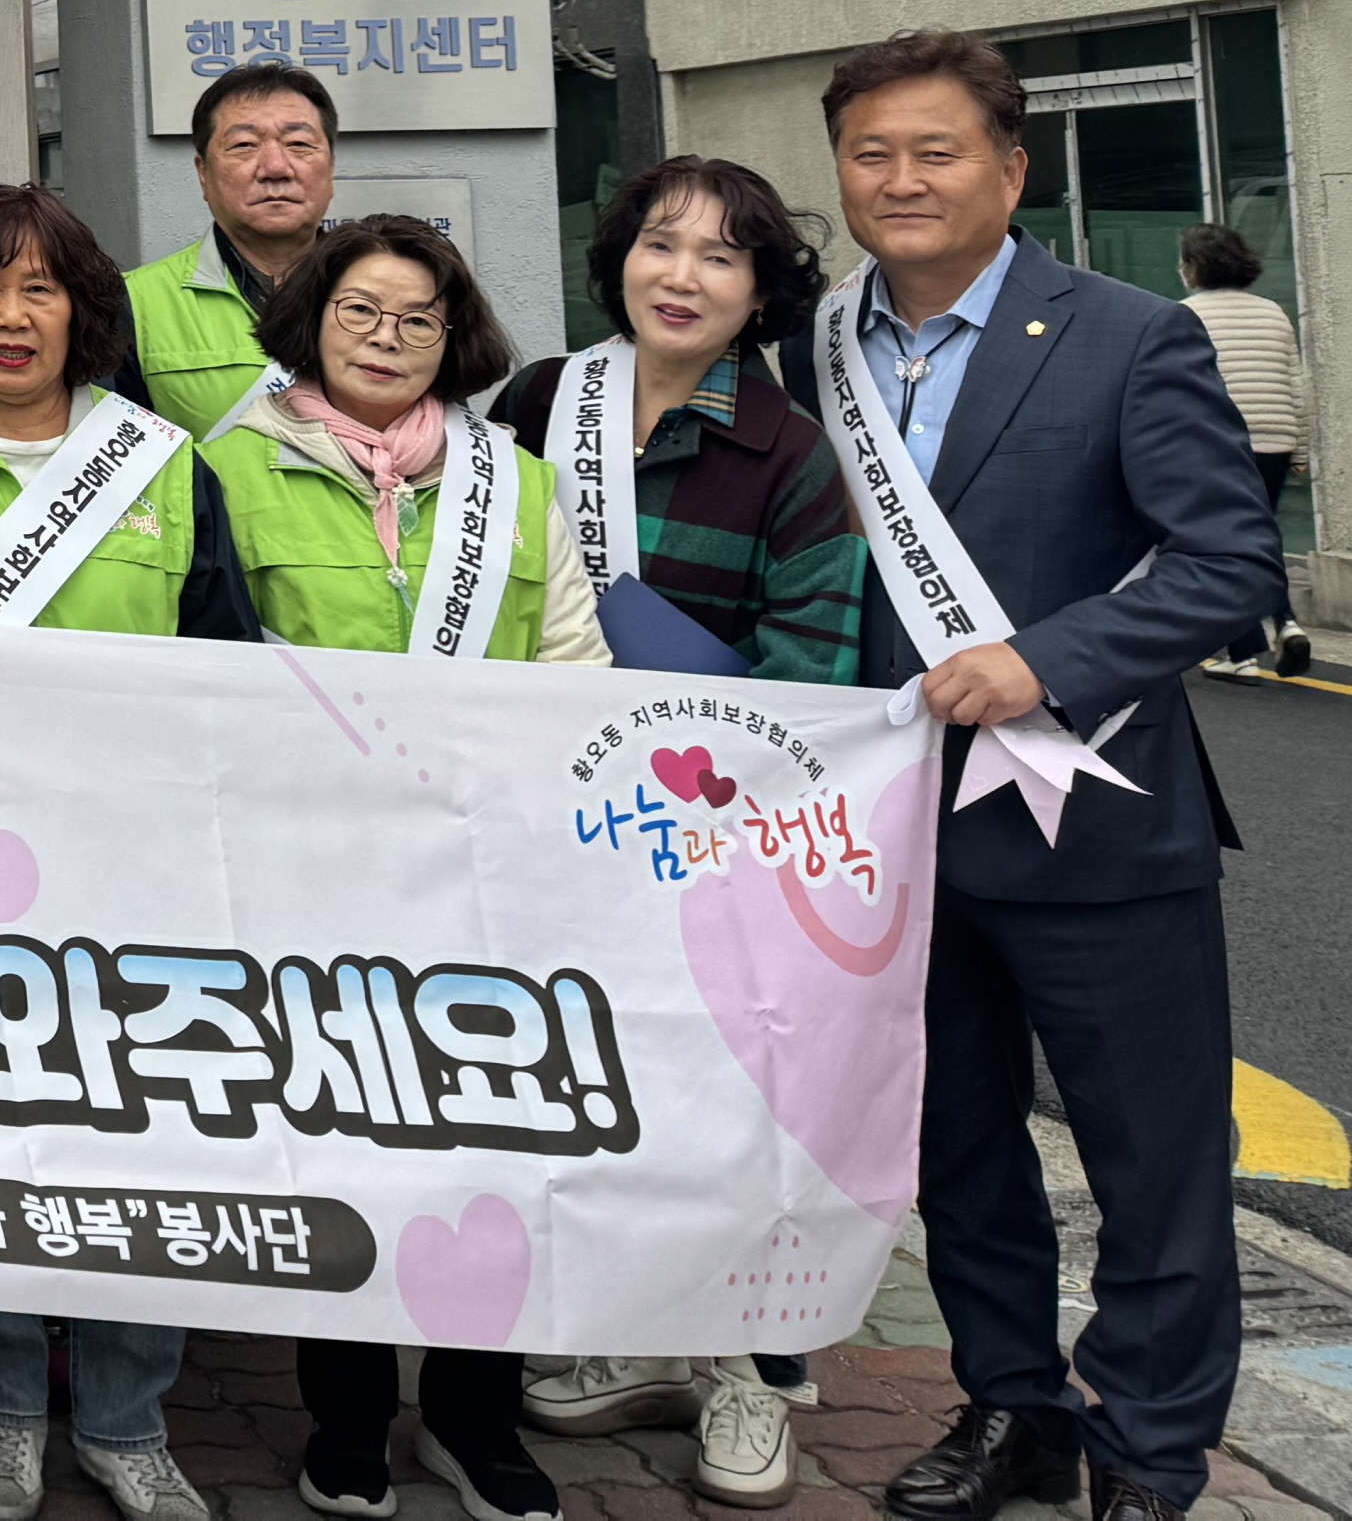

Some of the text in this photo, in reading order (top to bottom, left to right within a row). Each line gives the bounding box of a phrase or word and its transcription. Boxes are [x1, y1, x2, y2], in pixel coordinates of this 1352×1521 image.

[185, 15, 518, 78] 행정복지센터
[828, 304, 977, 639] 황오동지역사회보장협의체
[571, 697, 826, 783] 황오동 지역사회보장협의체
[576, 783, 874, 896] 나눔과 행복
